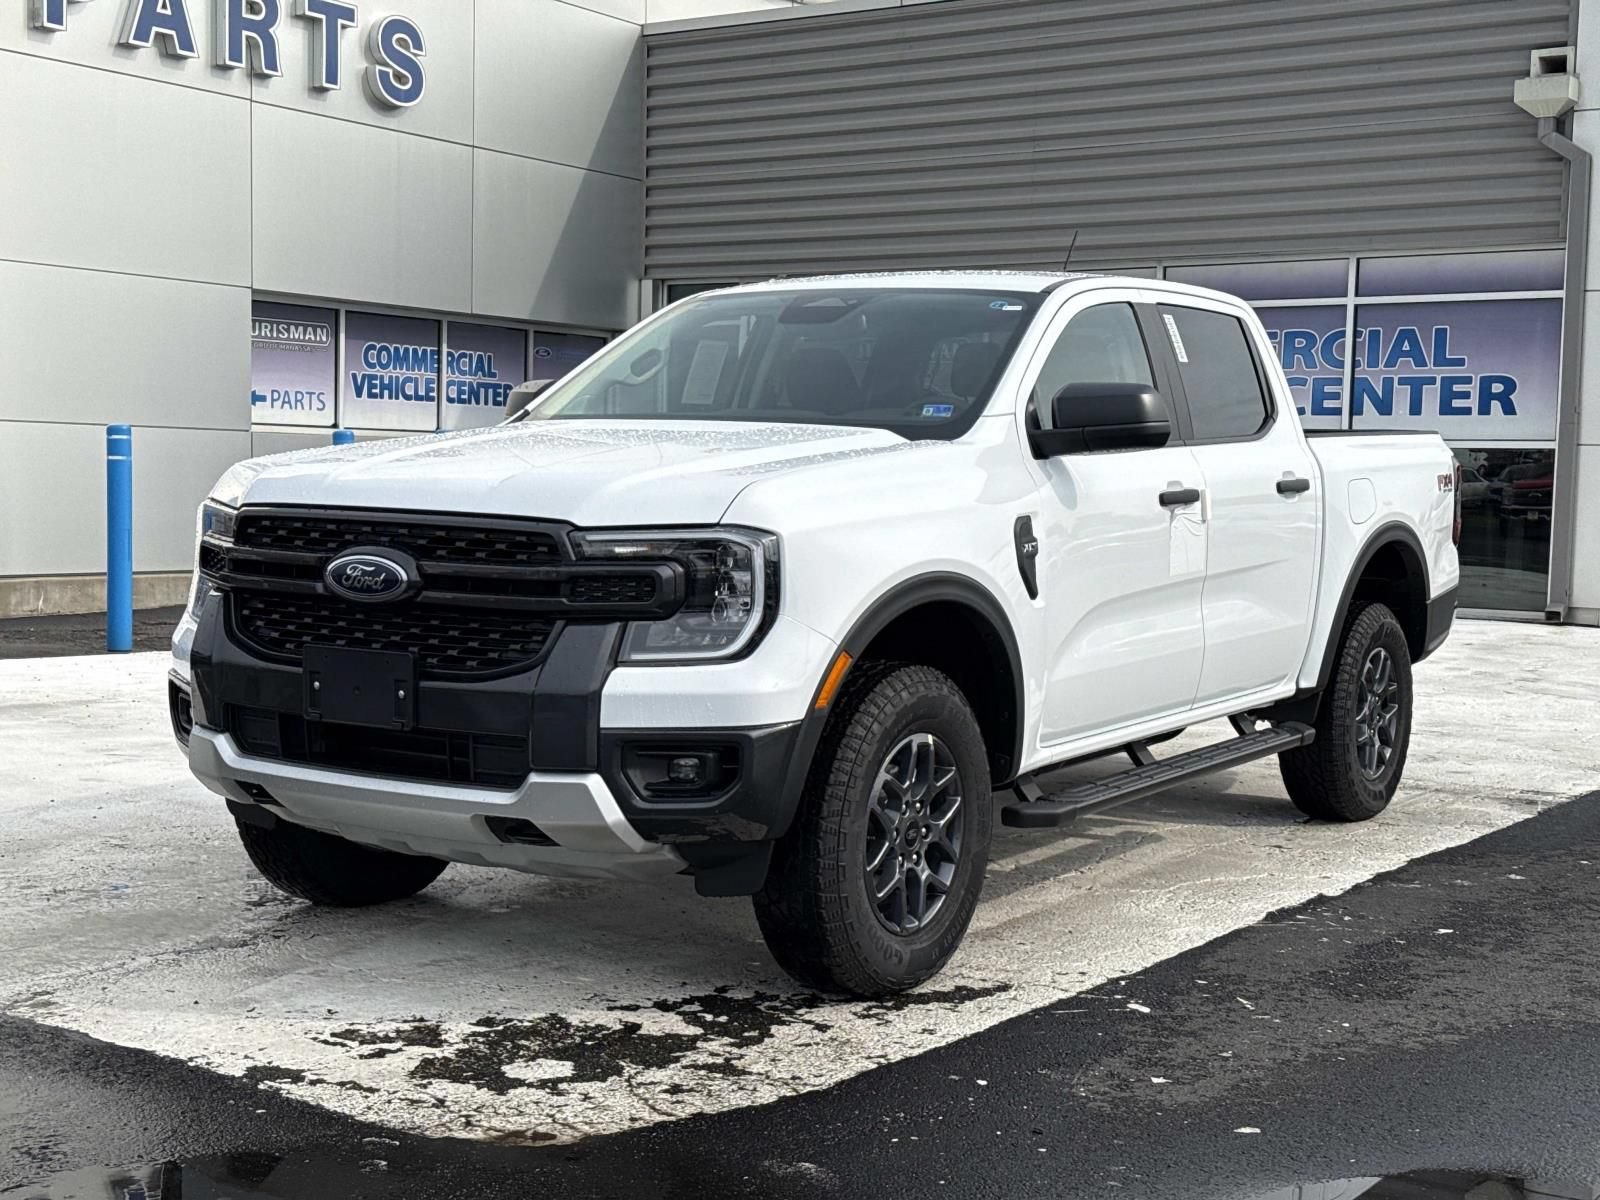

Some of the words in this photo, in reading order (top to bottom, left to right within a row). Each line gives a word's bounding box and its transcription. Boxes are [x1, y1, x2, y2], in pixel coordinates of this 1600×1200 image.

[362, 342, 498, 379] COMMERCIAL
[270, 389, 326, 411] PARTS
[351, 372, 436, 402] VEHICLE
[341, 563, 387, 589] Ford
